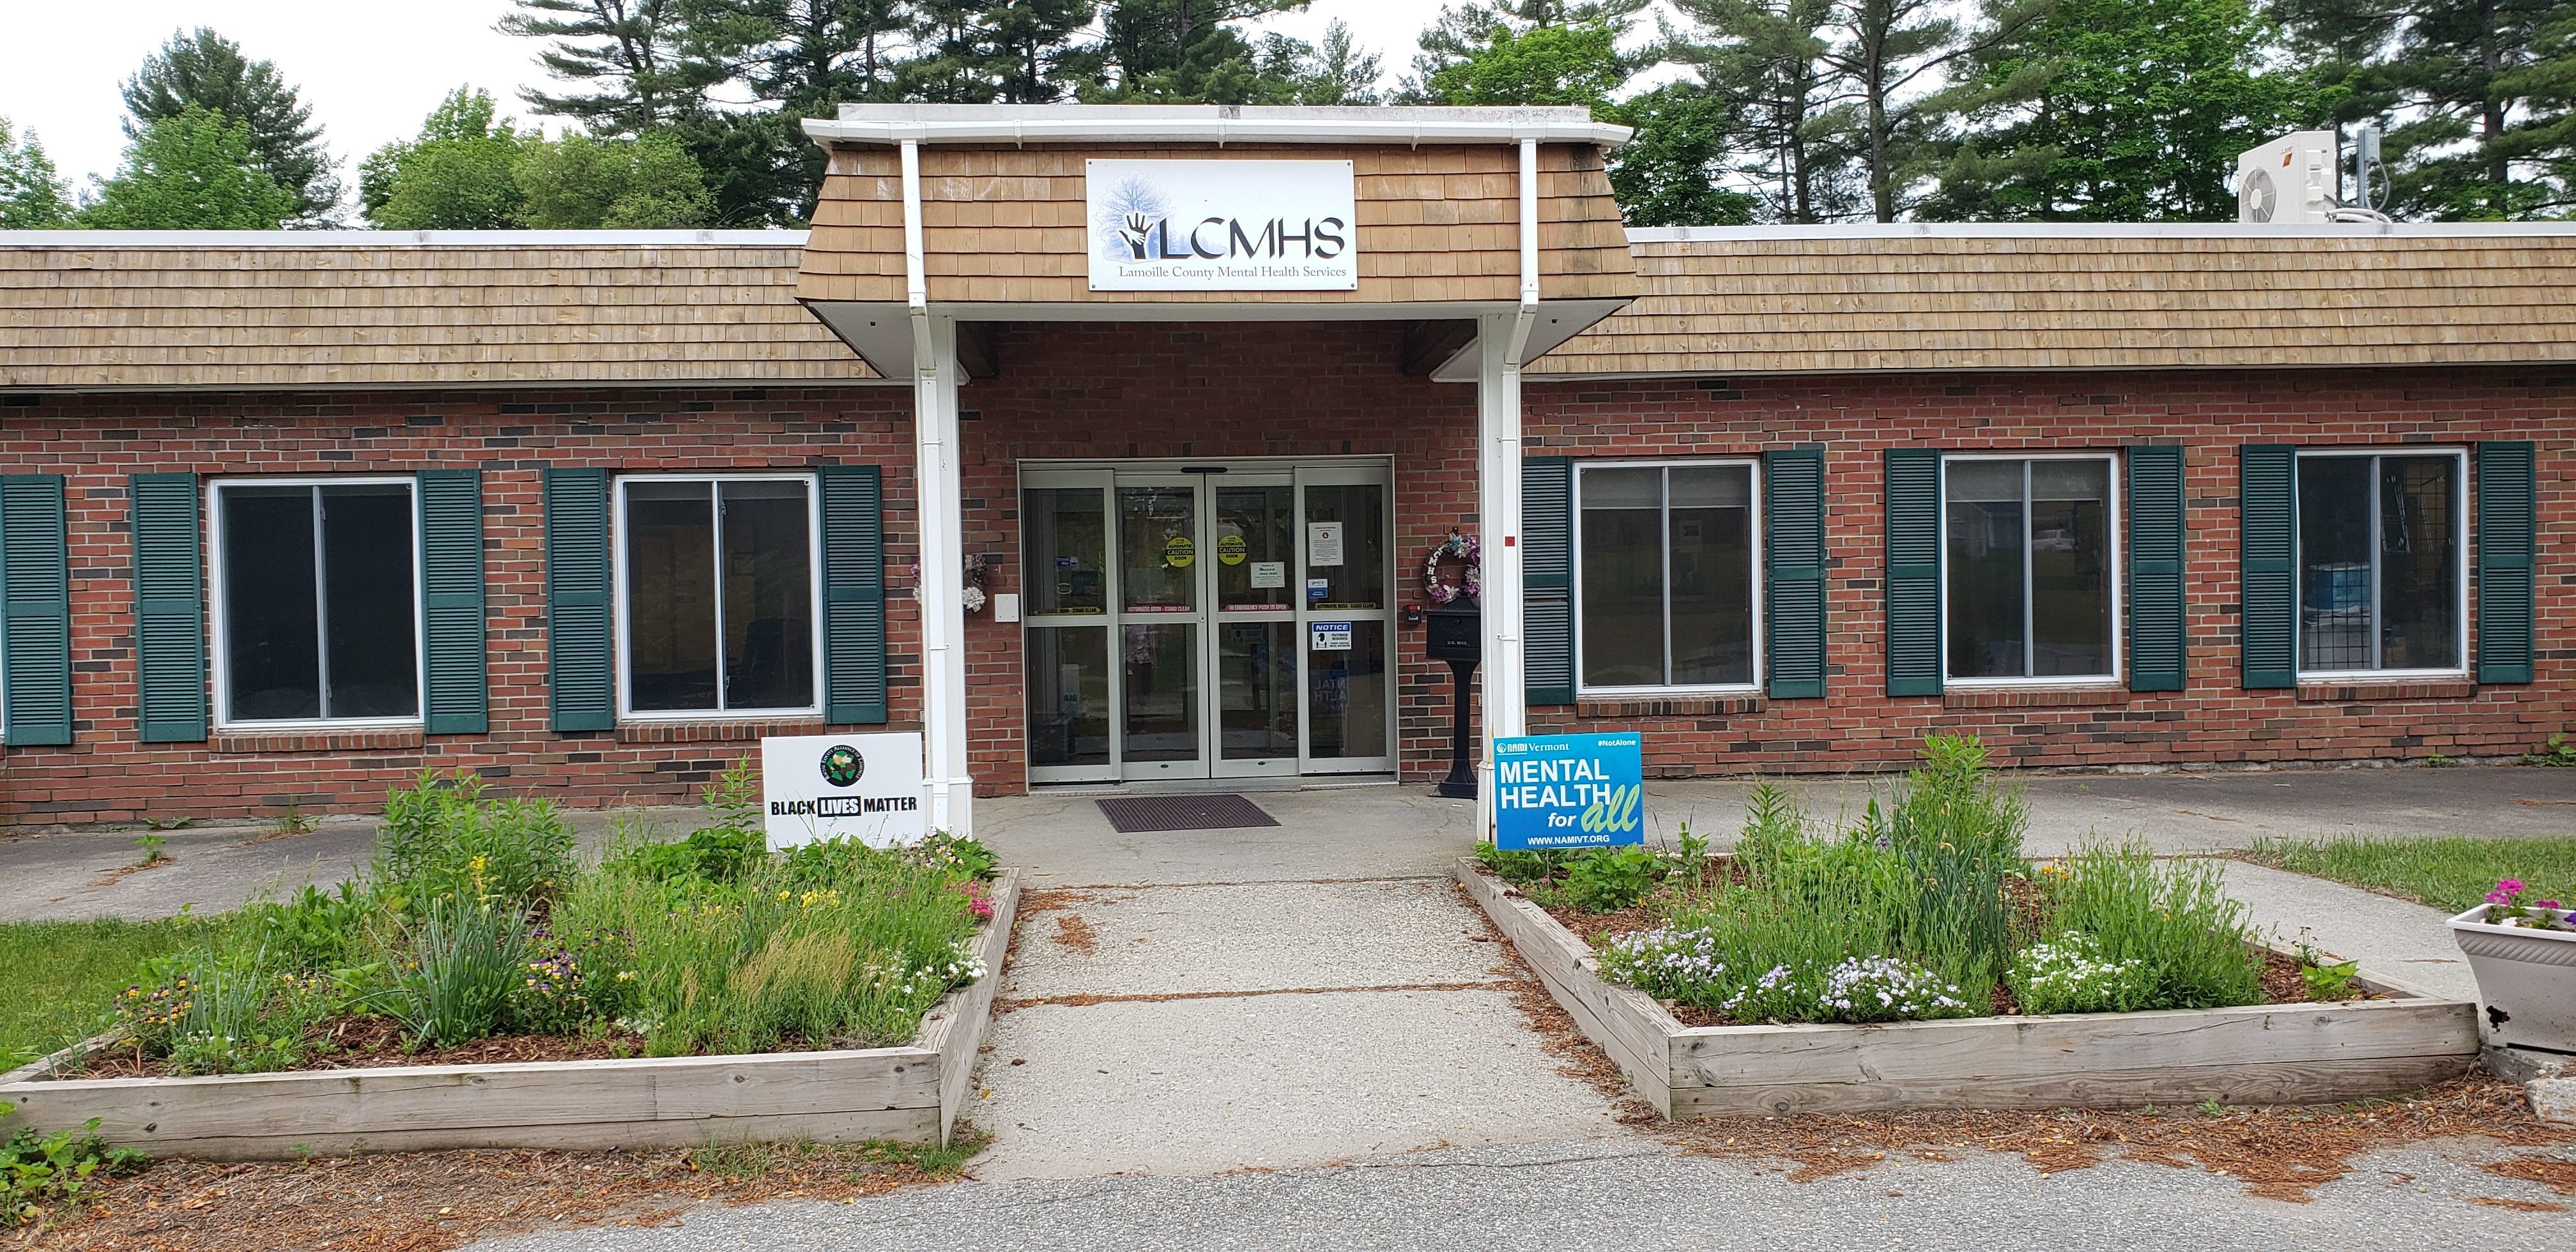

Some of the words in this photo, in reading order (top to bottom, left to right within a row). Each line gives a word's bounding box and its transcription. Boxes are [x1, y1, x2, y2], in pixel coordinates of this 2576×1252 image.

[1159, 217, 1345, 259] LCMHS
[1119, 266, 1169, 277] Lamoille
[1172, 266, 1214, 280] County
[1217, 266, 1257, 277] Mental
[1261, 266, 1300, 277] Health
[1303, 266, 1346, 277] Services
[1507, 743, 1528, 752] NAMI
[1528, 743, 1569, 752] Vermont
[1500, 758, 1610, 784] MENTAL
[771, 800, 816, 816] BLACK
[820, 798, 859, 815] LIVES
[864, 797, 917, 813] MATTER
[1501, 783, 1611, 809] HEALTH
[1547, 812, 1577, 827] for
[1581, 783, 1640, 833] all
[1528, 835, 1610, 845] WWW.NAMIVT.ORG
